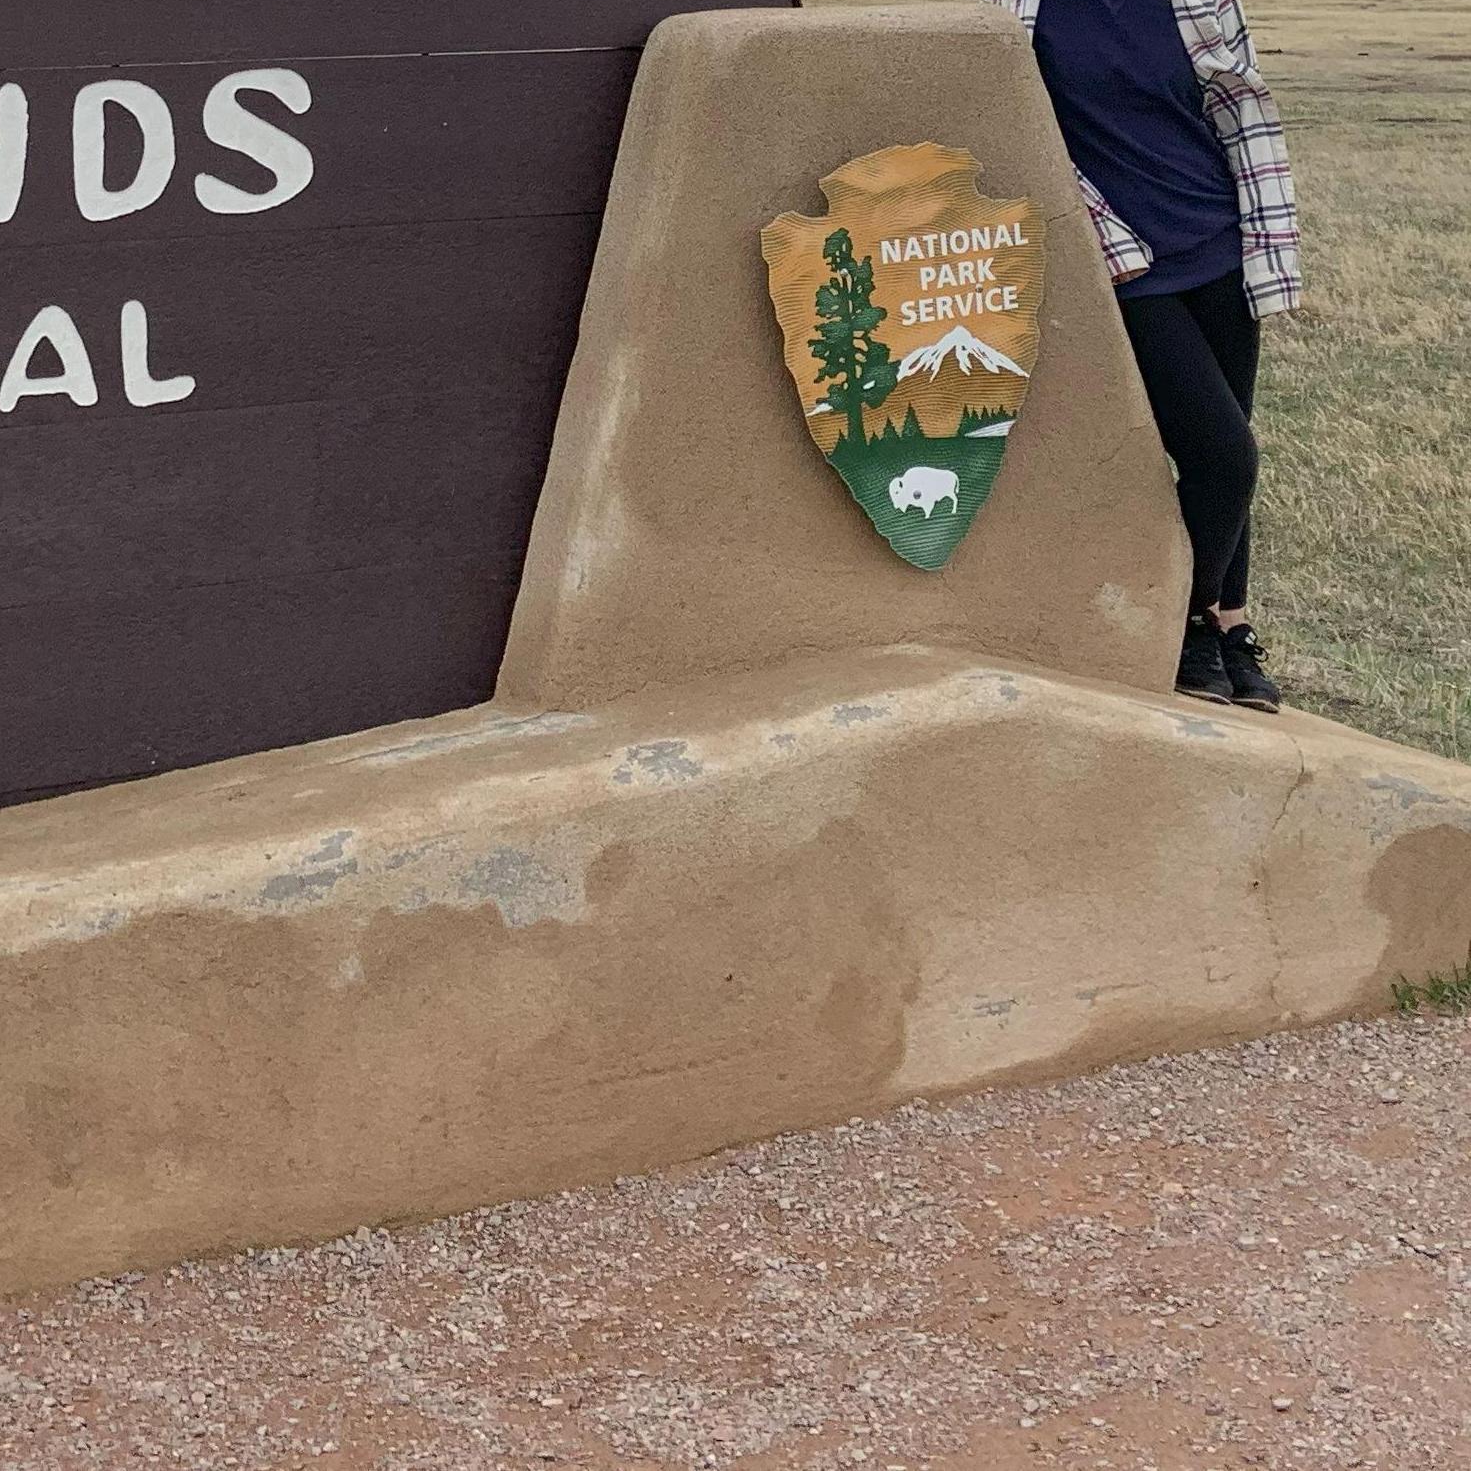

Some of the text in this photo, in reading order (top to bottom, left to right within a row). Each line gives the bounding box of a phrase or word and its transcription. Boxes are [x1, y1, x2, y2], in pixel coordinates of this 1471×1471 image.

[880, 223, 1029, 265] NATIONAL
[919, 257, 995, 291] PARK
[900, 285, 1019, 327] SERVICE
